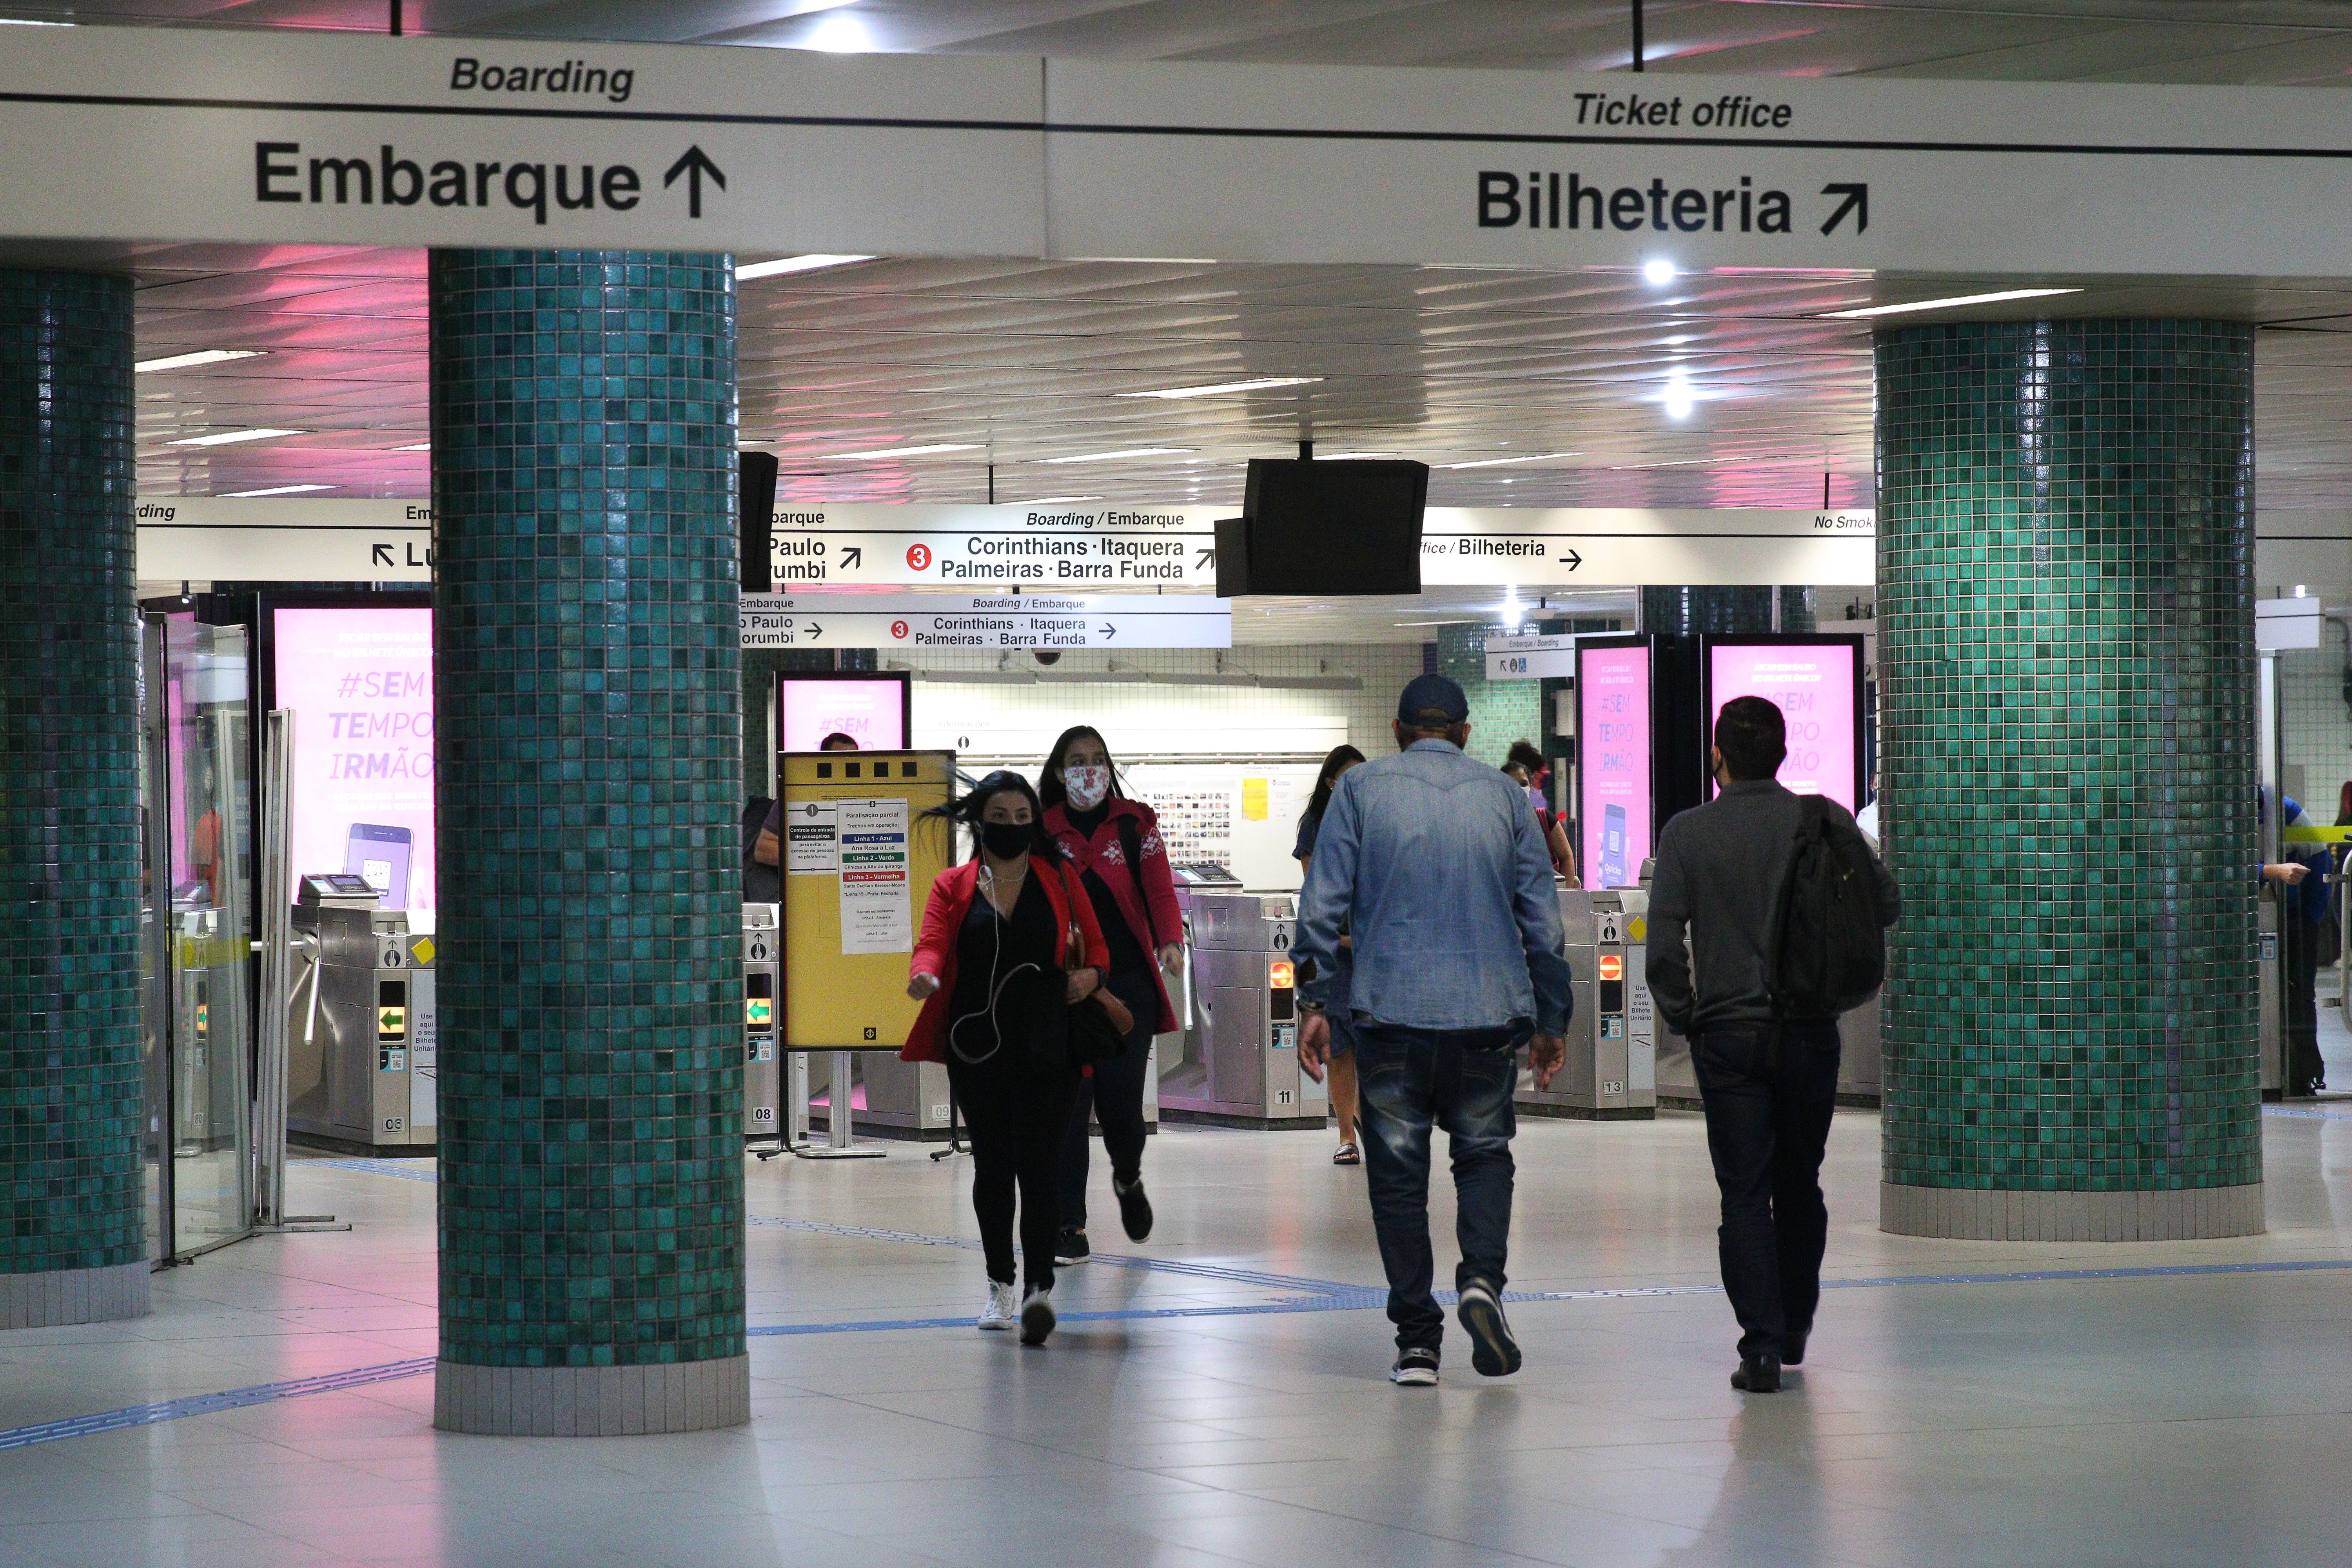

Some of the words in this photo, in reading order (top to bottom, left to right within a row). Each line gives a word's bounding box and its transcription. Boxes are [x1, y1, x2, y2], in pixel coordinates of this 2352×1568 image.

[450, 58, 634, 101] Boarding
[1574, 93, 1682, 125] Ticket
[1692, 96, 1791, 127] office
[256, 142, 640, 225] Embarque
[1478, 172, 1792, 233] Bilheteria
[136, 504, 175, 521] ding
[1027, 513, 1093, 528] Boarding
[1098, 512, 1104, 525] /
[1108, 513, 1184, 528] Embarque
[1815, 516, 1832, 528] No
[1837, 516, 1875, 528] Smok
[967, 537, 1087, 555] Corinthians
[1101, 538, 1183, 559] Itaquera
[1459, 539, 1544, 555] Bilheteria
[913, 547, 926, 567] 3
[771, 561, 825, 579] umbi
[942, 561, 1043, 578] Palmeiras
[1058, 561, 1112, 578] Barra
[1120, 561, 1183, 579] Funda
[740, 599, 793, 610] Embarque
[973, 599, 1020, 610] Boarding
[1024, 599, 1029, 608] /
[1032, 599, 1085, 610] Embarque
[752, 616, 793, 628] Paulo
[934, 617, 1013, 629] Corinthians
[1031, 619, 1085, 632] Itaquera
[394, 633, 428, 642] SALDO
[742, 632, 793, 643] orumbi
[895, 623, 905, 637] 3
[916, 633, 983, 645] Palmeiras
[1000, 633, 1036, 645] Barra
[1044, 634, 1085, 645] Funda
[1509, 640, 1533, 648] Embarque
[1537, 639, 1559, 647] Boarding
[338, 672, 425, 697] #SEM
[1602, 694, 1630, 713] #SEM
[328, 712, 433, 738] TEMPO
[819, 718, 868, 733] #SEM
[1599, 723, 1633, 742] TEMPO
[329, 747, 434, 779] IRMÃO
[1599, 748, 1633, 771] IRMÃO
[1604, 863, 1621, 875] Quicko
[1606, 1082, 1620, 1092] 13
[1279, 1091, 1290, 1103] 11
[756, 1109, 771, 1119] 08
[936, 1106, 949, 1116] 09
[386, 1118, 402, 1130] 06
